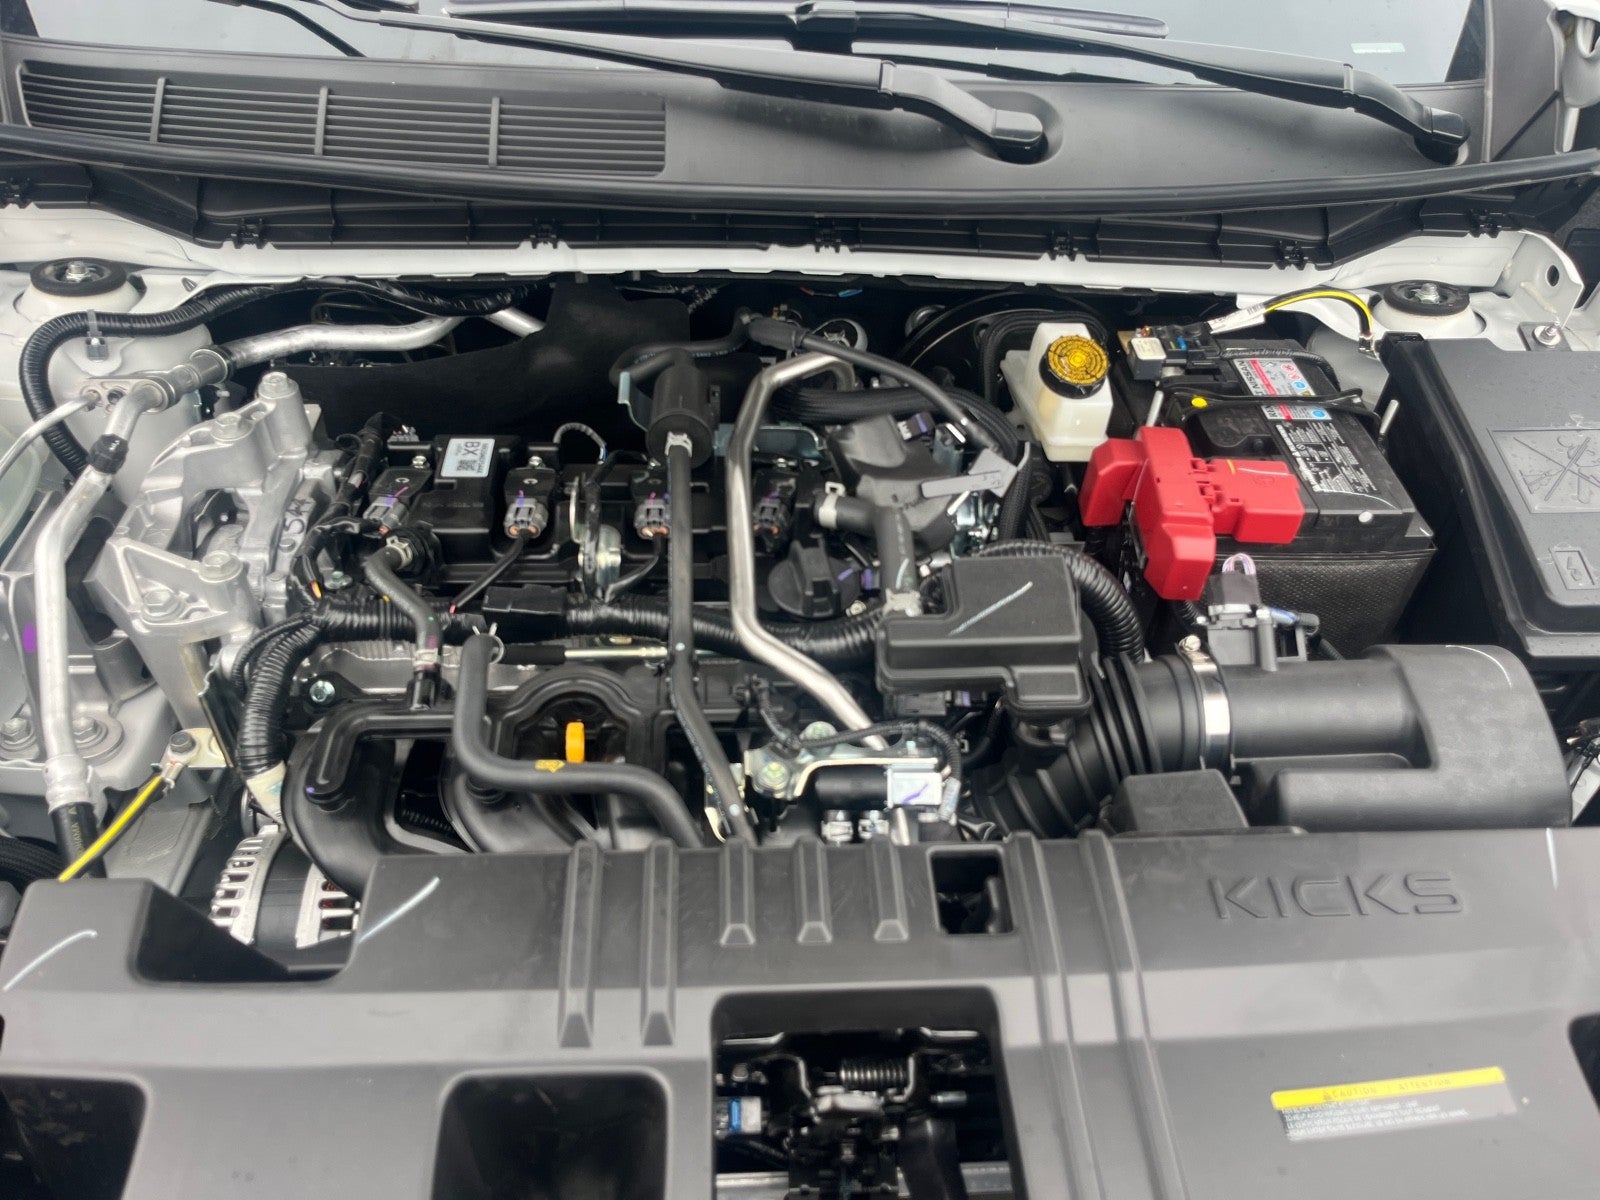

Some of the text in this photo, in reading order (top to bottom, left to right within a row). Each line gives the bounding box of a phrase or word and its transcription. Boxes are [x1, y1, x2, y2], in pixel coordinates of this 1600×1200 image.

[1238, 361, 1260, 390] NISSAN
[461, 441, 481, 456] BX
[1207, 872, 1464, 919] KICKS
[1331, 1079, 1453, 1099] CAUTION ATTENTION
